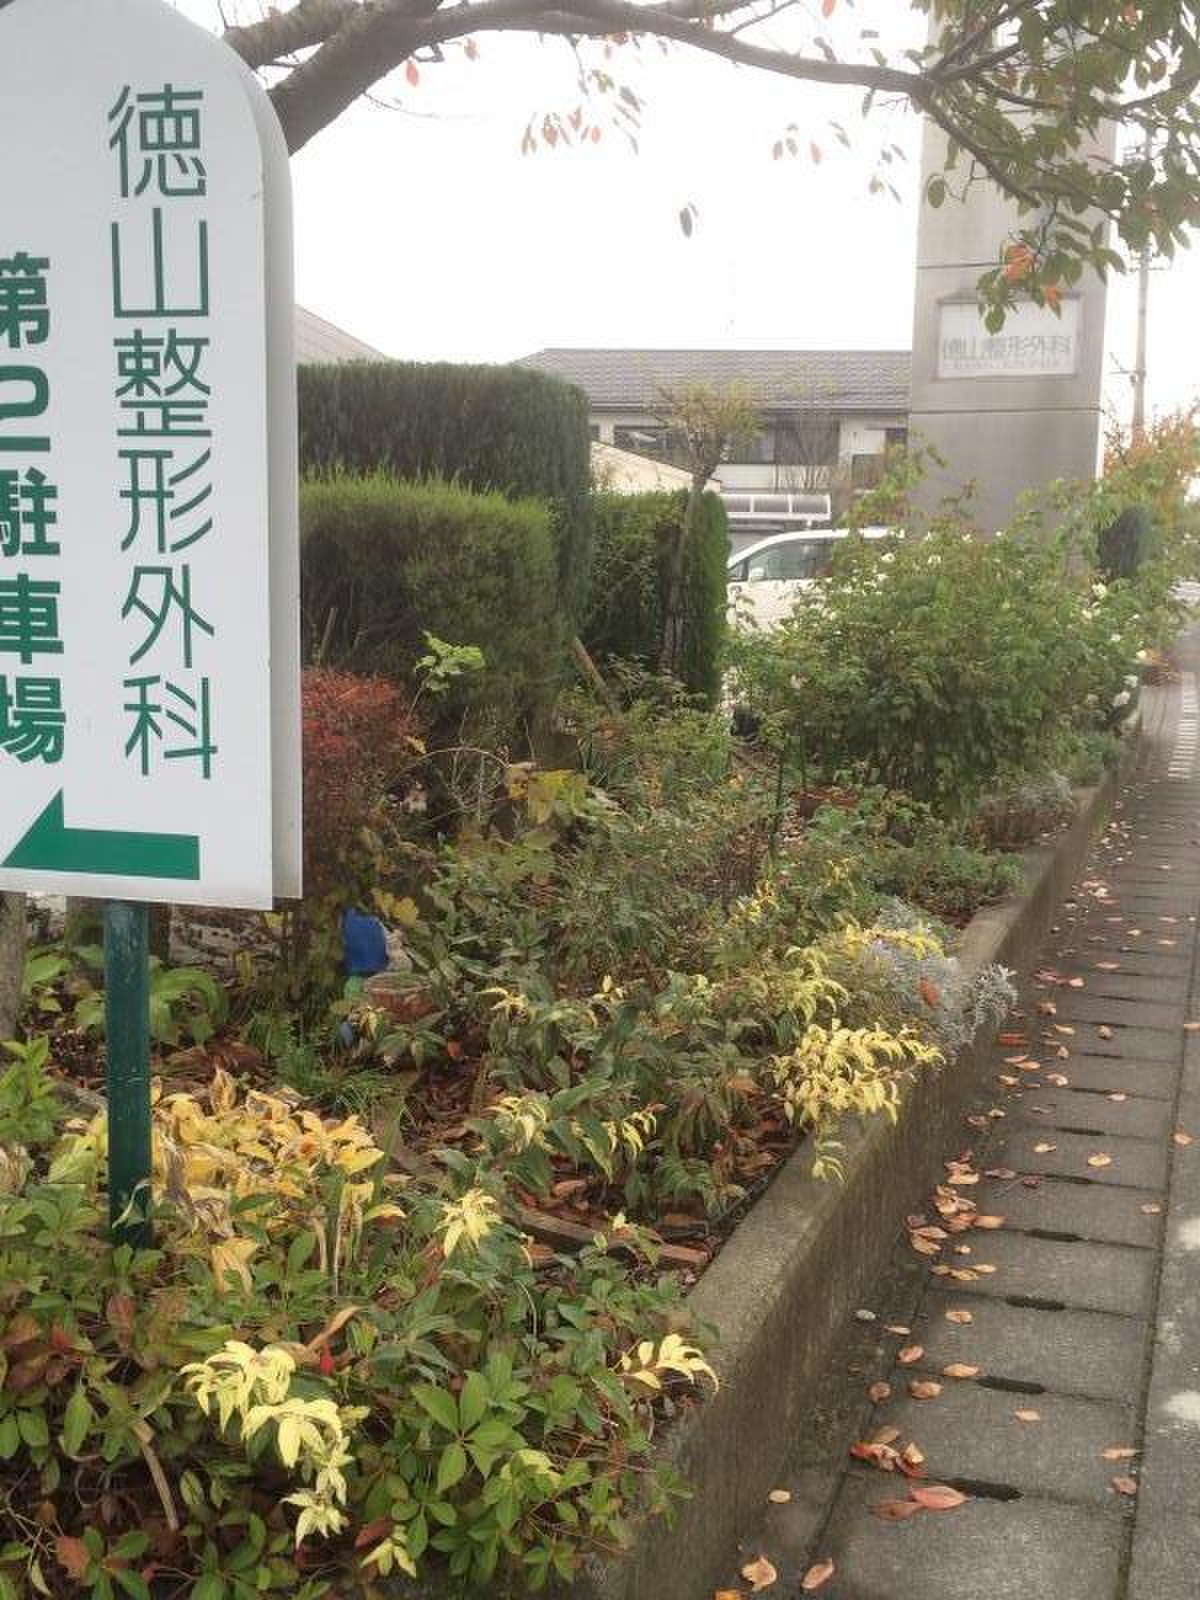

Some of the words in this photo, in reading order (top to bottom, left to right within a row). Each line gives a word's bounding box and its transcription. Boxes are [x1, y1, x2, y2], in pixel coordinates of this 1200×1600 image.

[108, 83, 217, 780] 徳山整形外科
